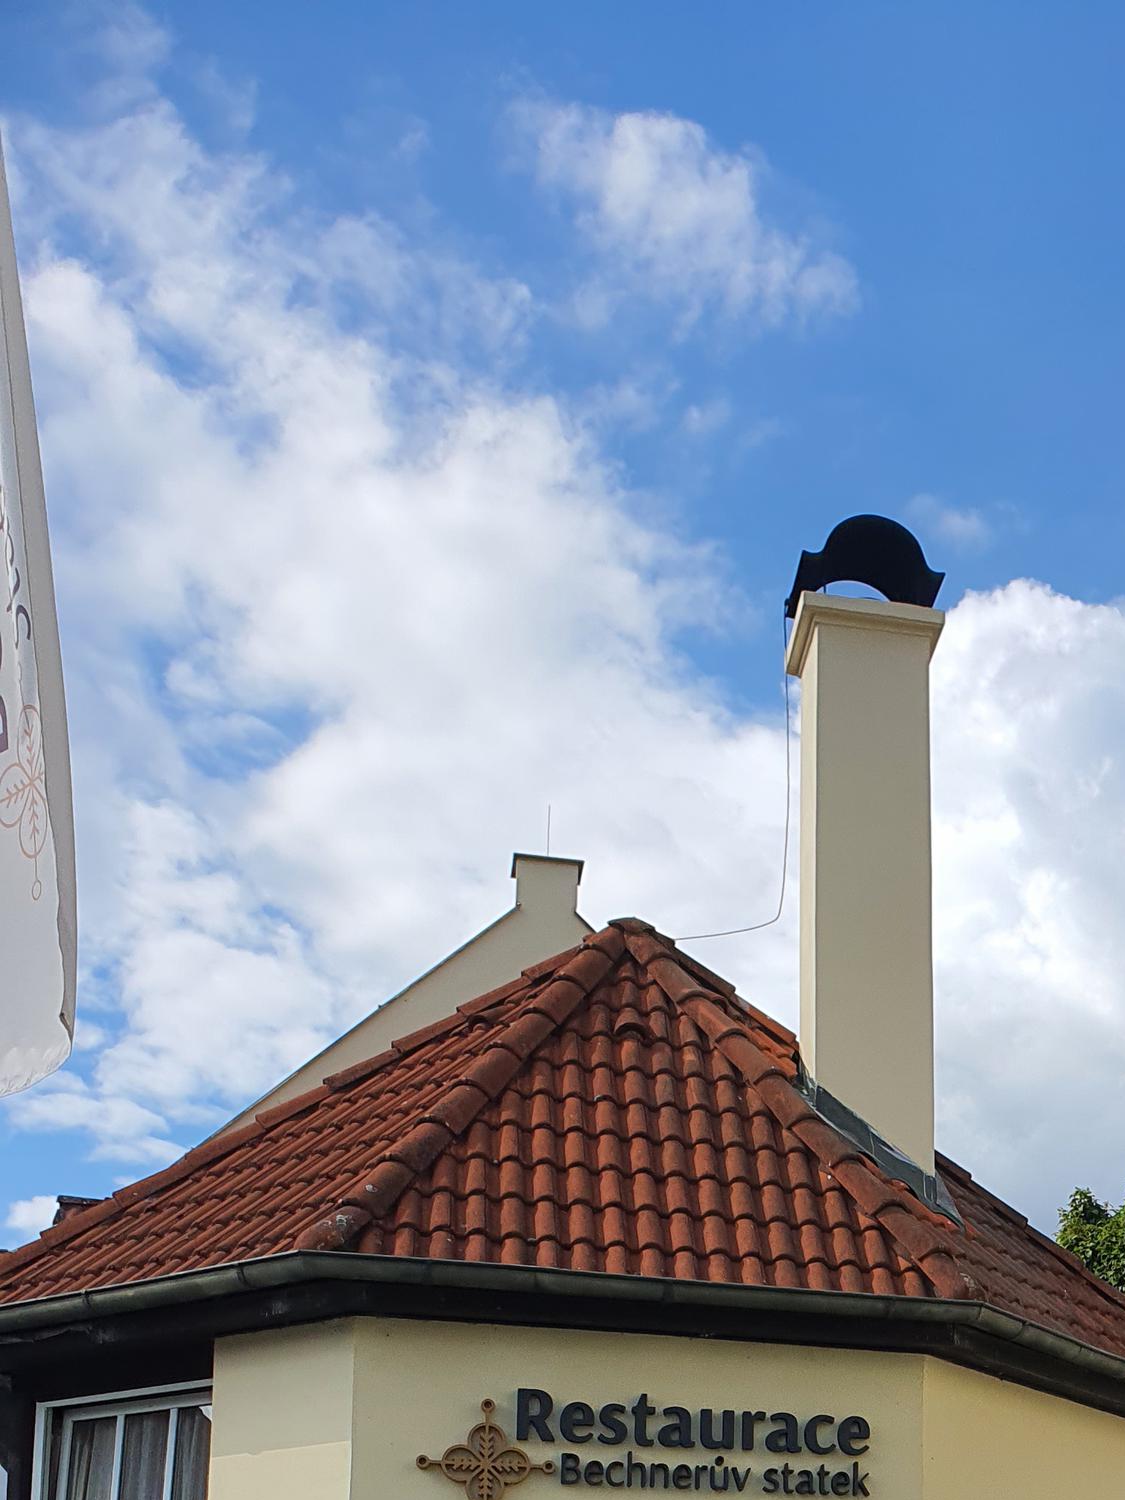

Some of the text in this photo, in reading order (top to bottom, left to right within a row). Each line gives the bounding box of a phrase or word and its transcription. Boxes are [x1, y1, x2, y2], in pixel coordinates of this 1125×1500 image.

[516, 1388, 870, 1456] Restaurace
[560, 1451, 870, 1498] Bechnerův statek
